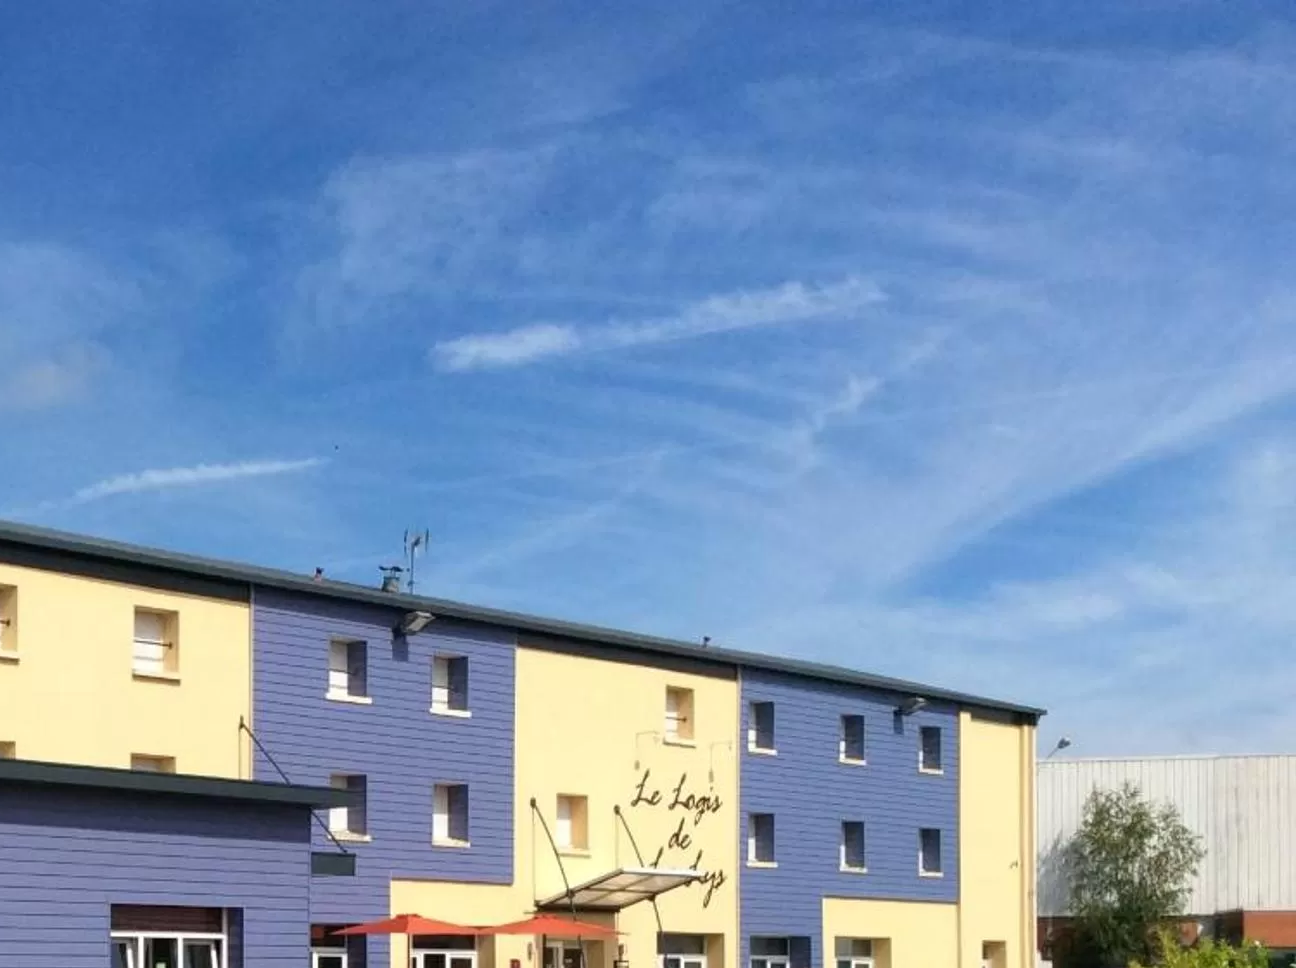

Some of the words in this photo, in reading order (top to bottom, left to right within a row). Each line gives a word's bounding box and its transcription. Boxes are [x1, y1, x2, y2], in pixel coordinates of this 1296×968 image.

[630, 769, 662, 807] Le
[668, 772, 723, 826] Logis
[668, 817, 692, 850] de
